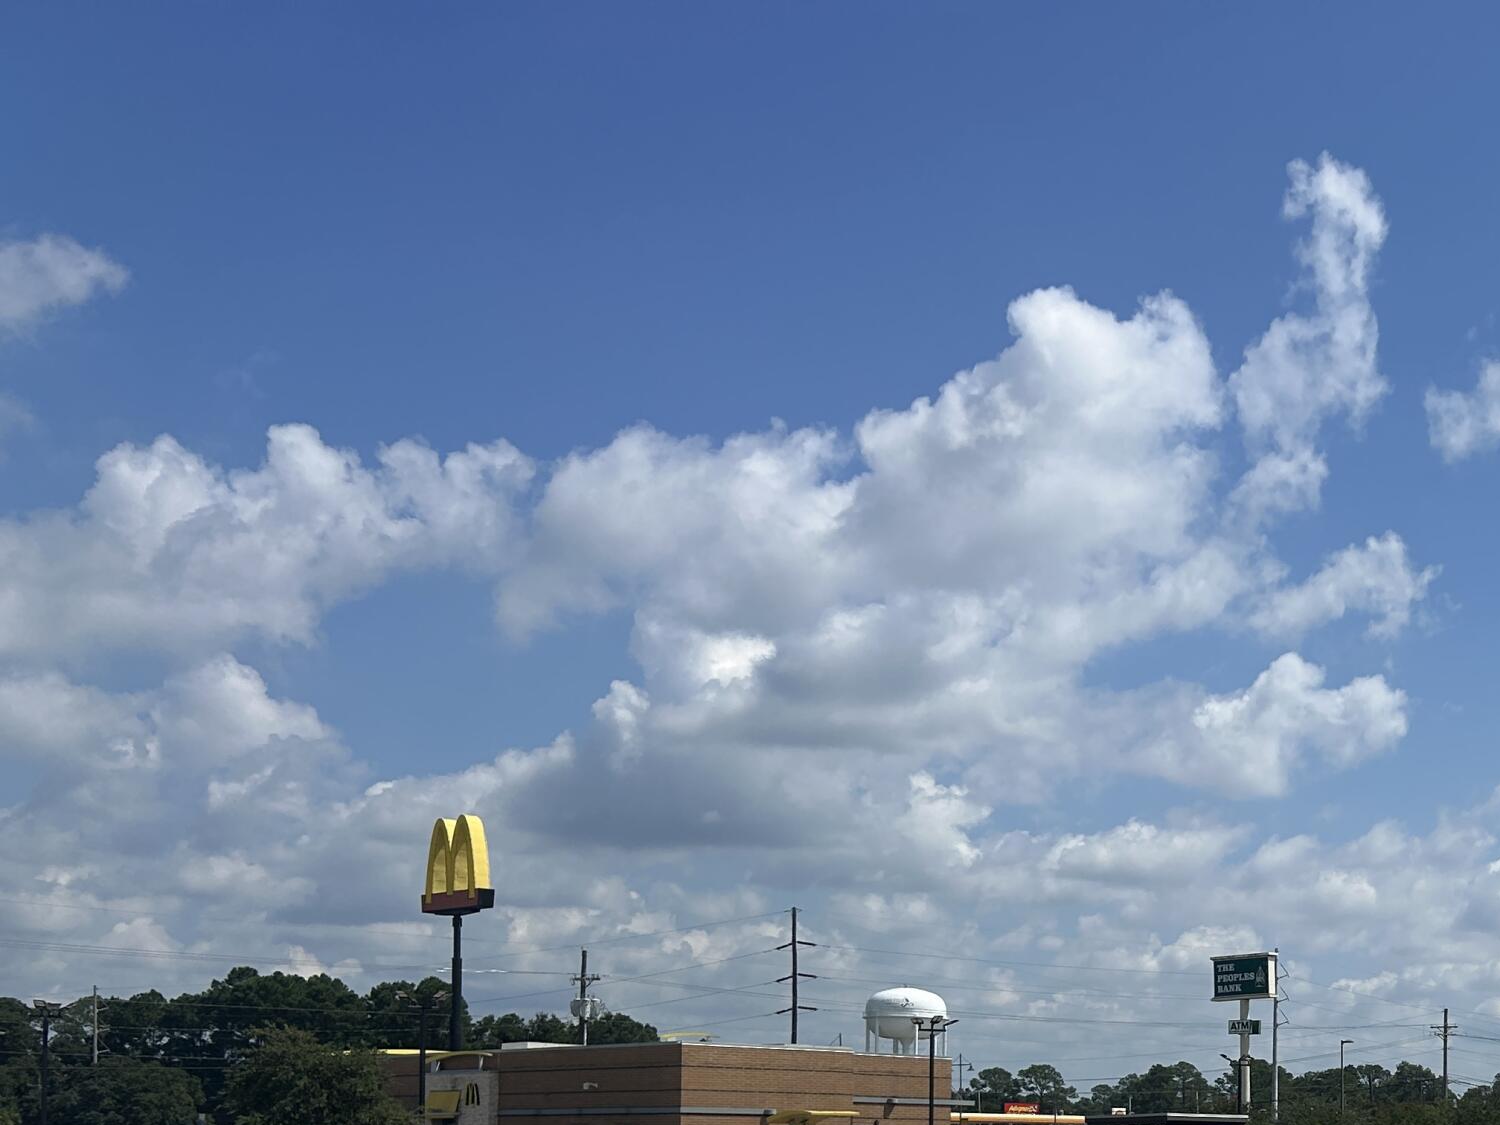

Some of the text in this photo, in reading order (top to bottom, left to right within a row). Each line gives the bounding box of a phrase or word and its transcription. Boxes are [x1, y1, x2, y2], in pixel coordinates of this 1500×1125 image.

[1216, 963, 1235, 973] THE
[1217, 972, 1256, 983] PEOPLES
[1217, 984, 1243, 993] BANK
[1230, 1021, 1250, 1030] ATM
